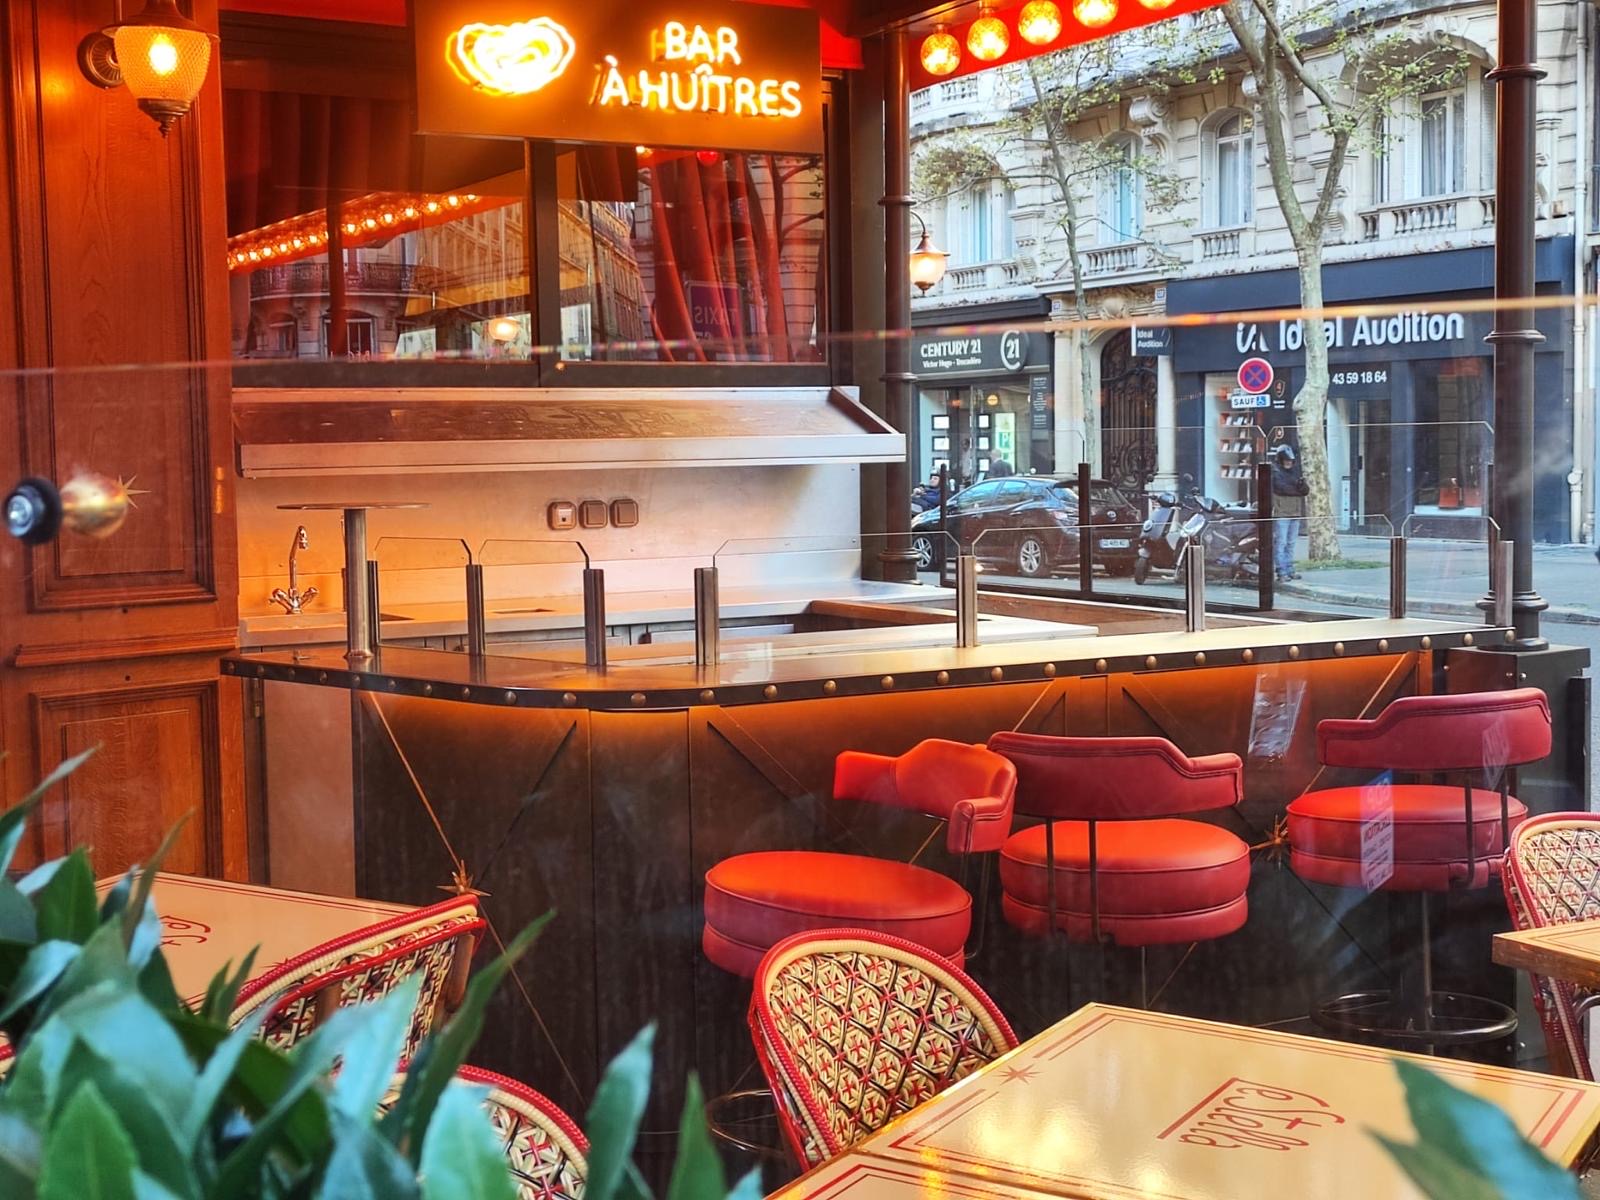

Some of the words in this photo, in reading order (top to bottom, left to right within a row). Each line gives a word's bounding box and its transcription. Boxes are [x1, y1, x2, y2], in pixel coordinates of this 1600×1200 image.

[665, 21, 741, 65] BAR
[600, 55, 630, 106] À
[639, 64, 802, 118] HUÎTRES
[1137, 329, 1153, 339] Ideal
[1279, 315, 1343, 351] Idal
[1351, 309, 1465, 347] Audition
[921, 339, 970, 358] CENTURY
[970, 338, 982, 354] 21
[1006, 338, 1020, 359] 21
[1137, 340, 1163, 348] Audition
[1332, 373, 1345, 385] 43
[1346, 372, 1359, 384] 59
[1361, 371, 1373, 384] 18
[1374, 370, 1388, 383] 64
[1233, 396, 1255, 406] SAUF
